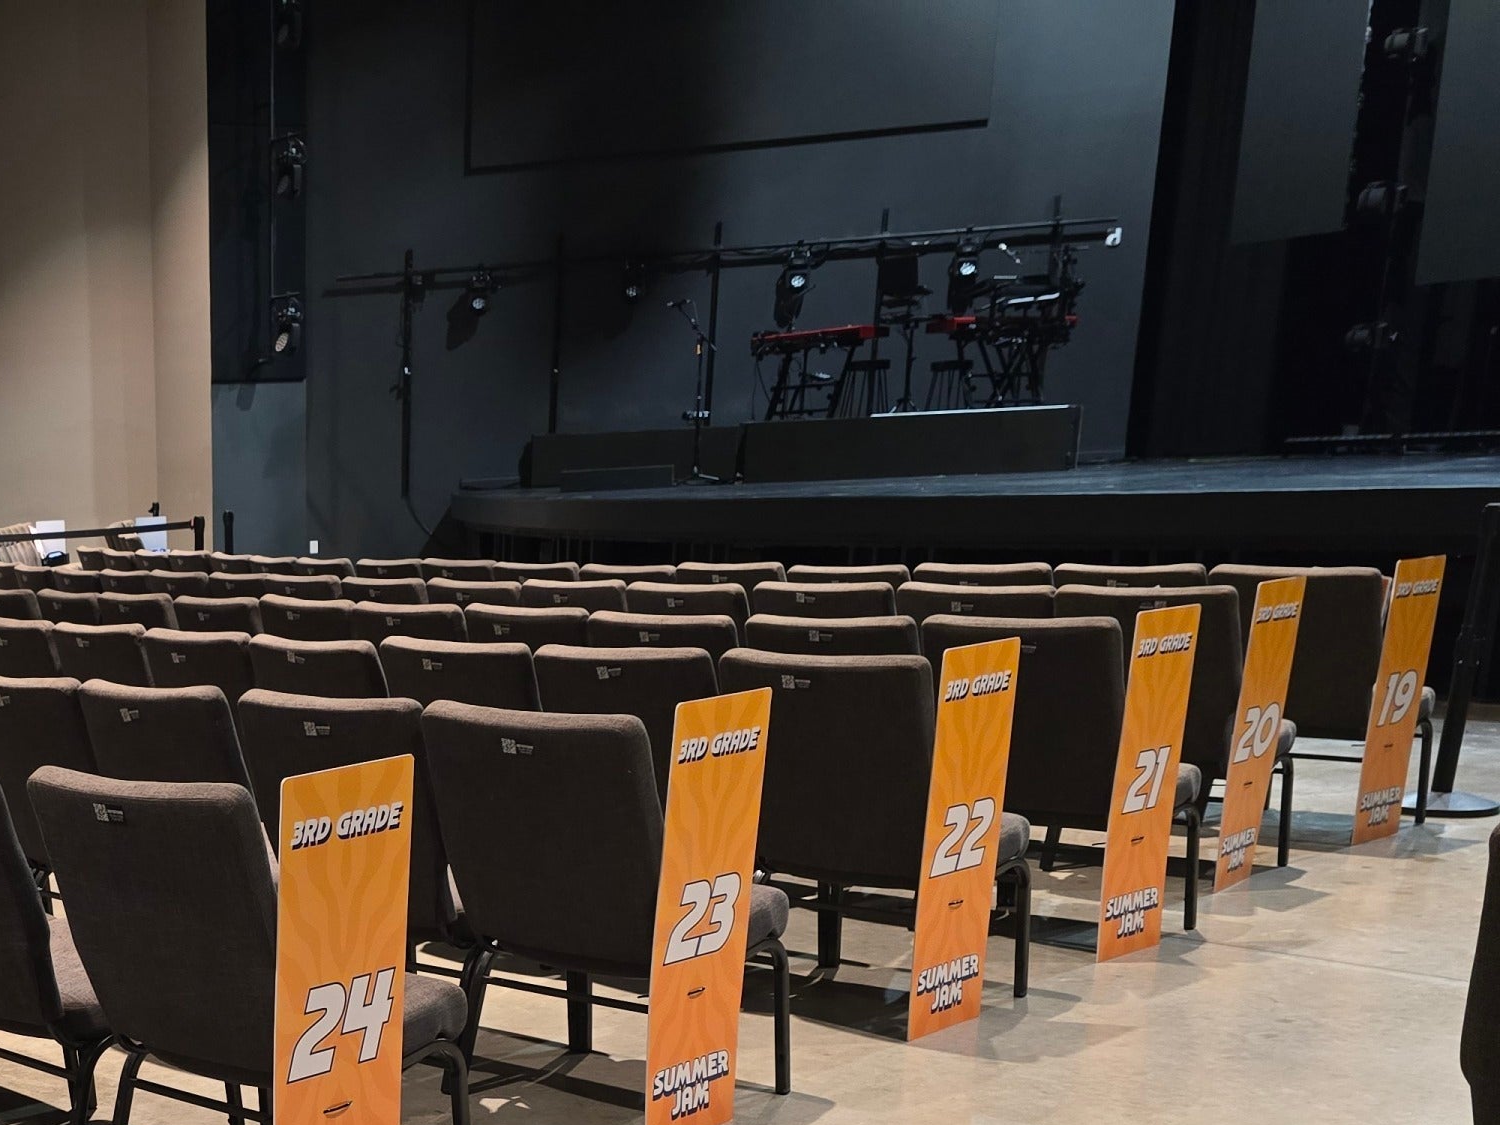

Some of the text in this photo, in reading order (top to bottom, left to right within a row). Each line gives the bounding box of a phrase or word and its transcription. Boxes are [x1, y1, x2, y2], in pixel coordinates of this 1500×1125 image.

[1273, 602, 1300, 620] GRADE
[1137, 632, 1193, 658] 3RD GRADE
[945, 670, 1012, 702] 3RD GRADE
[1376, 668, 1418, 728] 19
[678, 726, 761, 764] 3RD GRADE
[1233, 702, 1281, 764] 20
[1121, 745, 1172, 815] 21
[1360, 785, 1401, 813] SUMMER
[290, 801, 404, 850] 3RD GRADE
[929, 797, 996, 879] 22
[1221, 827, 1257, 858] SUMMER
[663, 872, 742, 966] 23
[1105, 887, 1159, 921] SUMMER
[1117, 910, 1145, 939] JAM
[917, 953, 979, 996] SUMMER
[931, 980, 962, 1014] JAM
[286, 966, 396, 1084] 24
[653, 1049, 729, 1101] SUMMER
[671, 1080, 709, 1121] JAM
